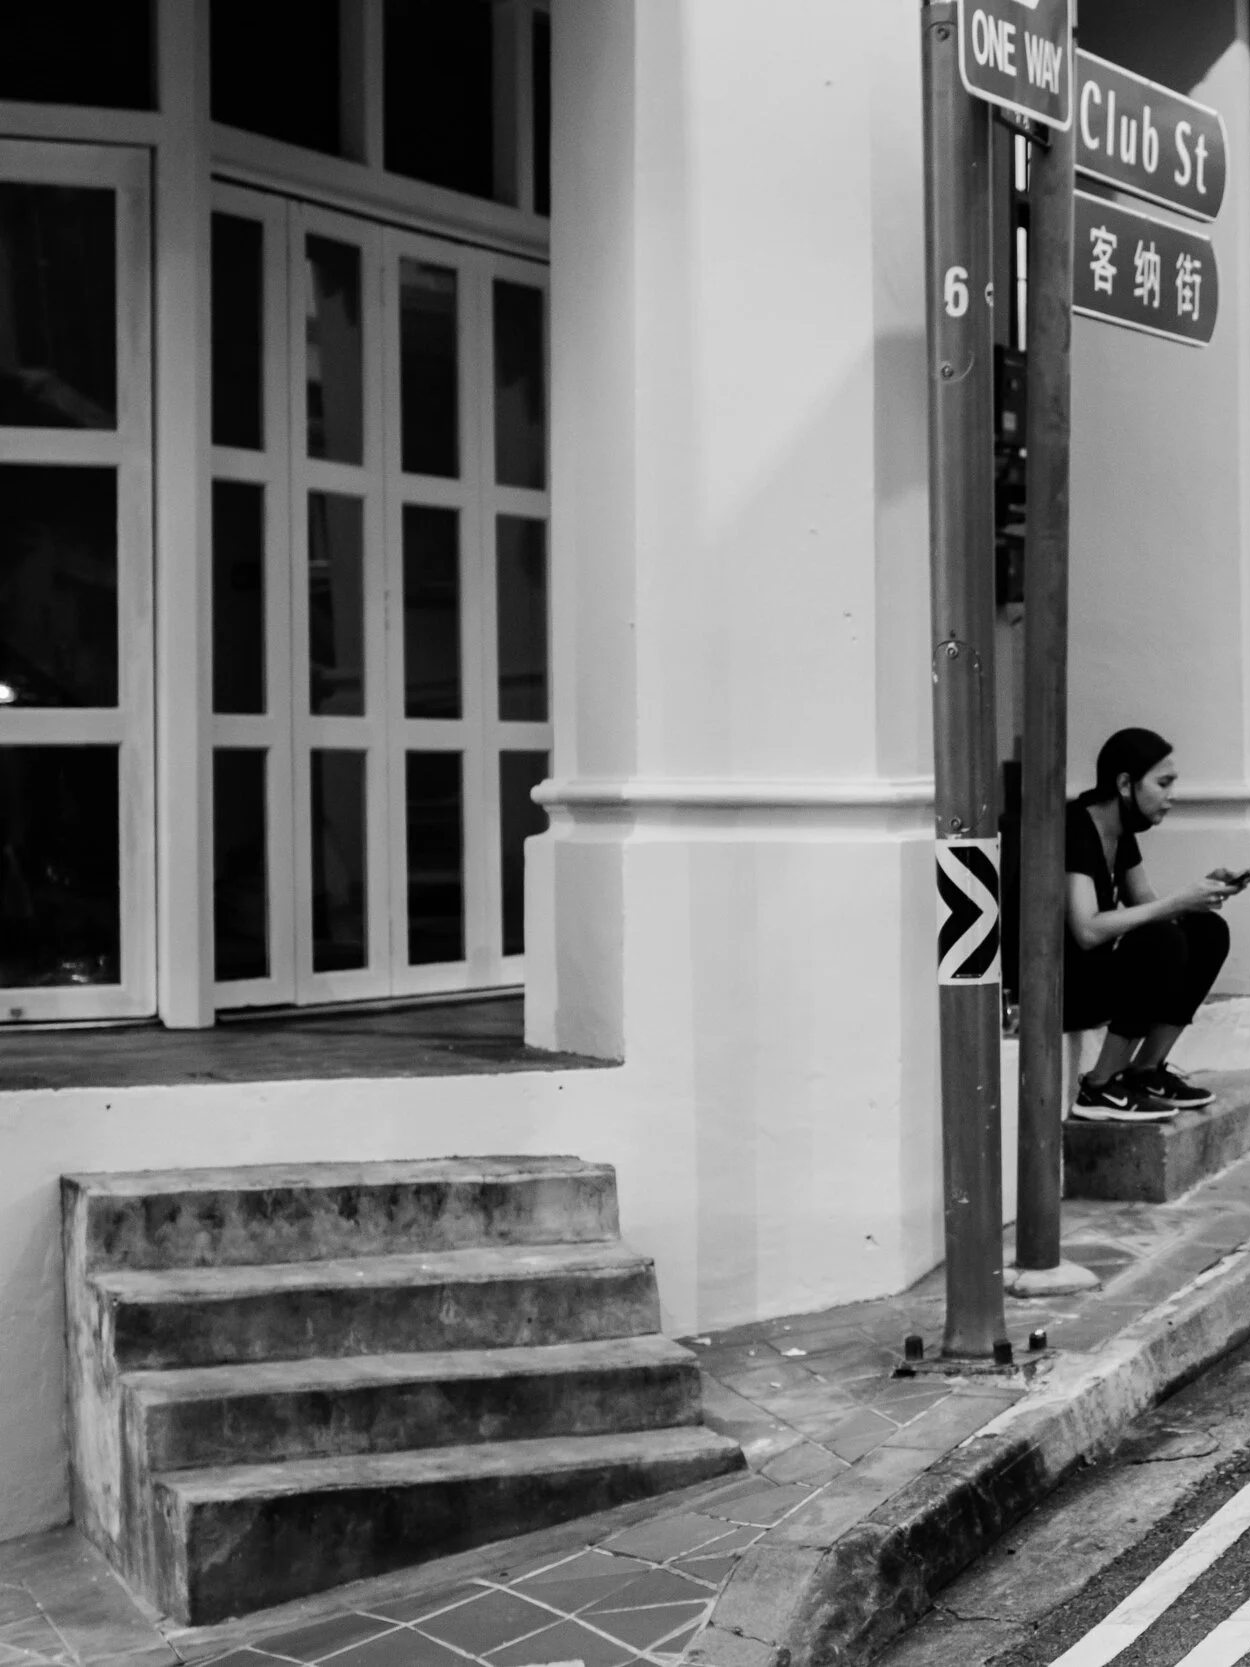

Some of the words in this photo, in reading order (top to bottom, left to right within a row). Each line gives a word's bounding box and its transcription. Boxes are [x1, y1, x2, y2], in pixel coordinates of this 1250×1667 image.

[971, 9, 1017, 77] ONE
[1024, 31, 1063, 94] WAY
[1079, 80, 1160, 173] Club
[1173, 120, 1209, 194] St
[944, 265, 969, 318] 6
[1089, 225, 1202, 322] 客纳街
